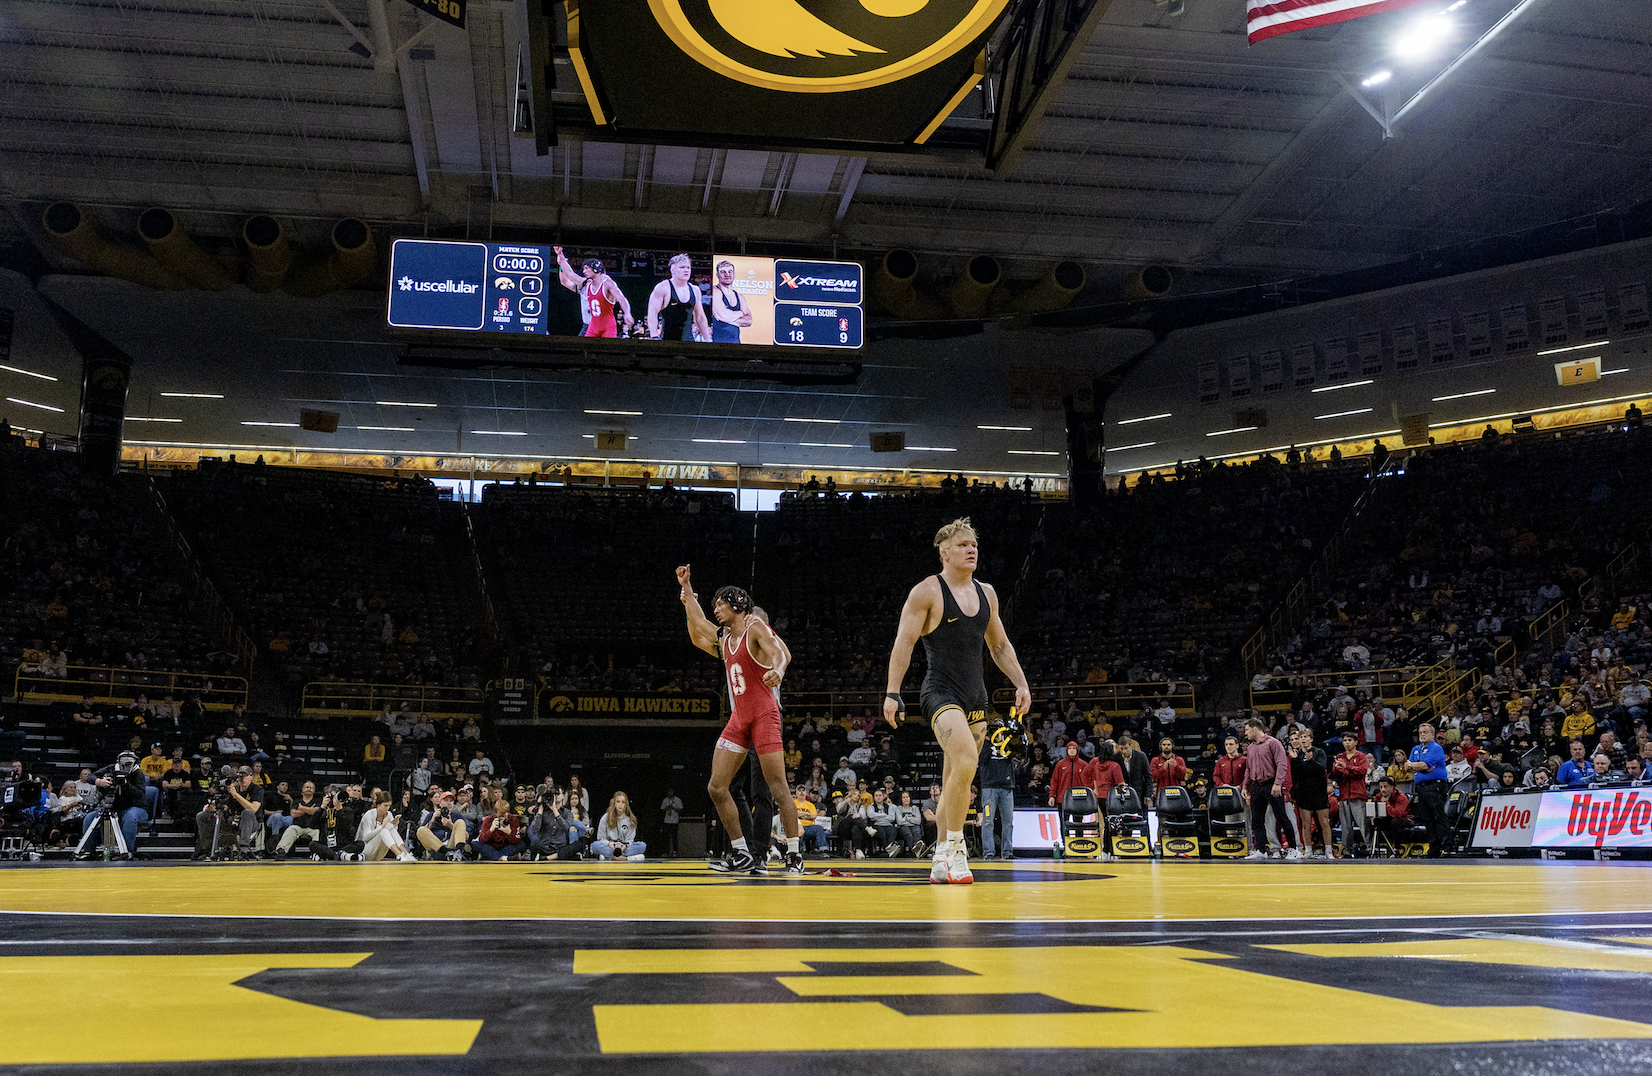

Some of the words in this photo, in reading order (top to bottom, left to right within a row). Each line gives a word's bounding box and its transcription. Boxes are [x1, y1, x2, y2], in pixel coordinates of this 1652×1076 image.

[499, 258, 538, 270] 0:00.0
[415, 280, 478, 294] uscellular
[528, 280, 534, 290] 1
[732, 280, 774, 290] NELSON
[798, 277, 858, 288] XTREAM
[736, 288, 768, 296] BRANDS
[526, 300, 534, 310] 4
[801, 308, 817, 316] TEAM
[818, 309, 837, 318] SCORE
[789, 331, 804, 341] 18
[840, 332, 848, 343] 9
[1575, 368, 1582, 376] E
[657, 464, 710, 480] IOWA
[577, 697, 620, 712] IOWA
[624, 698, 710, 713] HAWKEYES
[1481, 805, 1531, 836] HyVee
